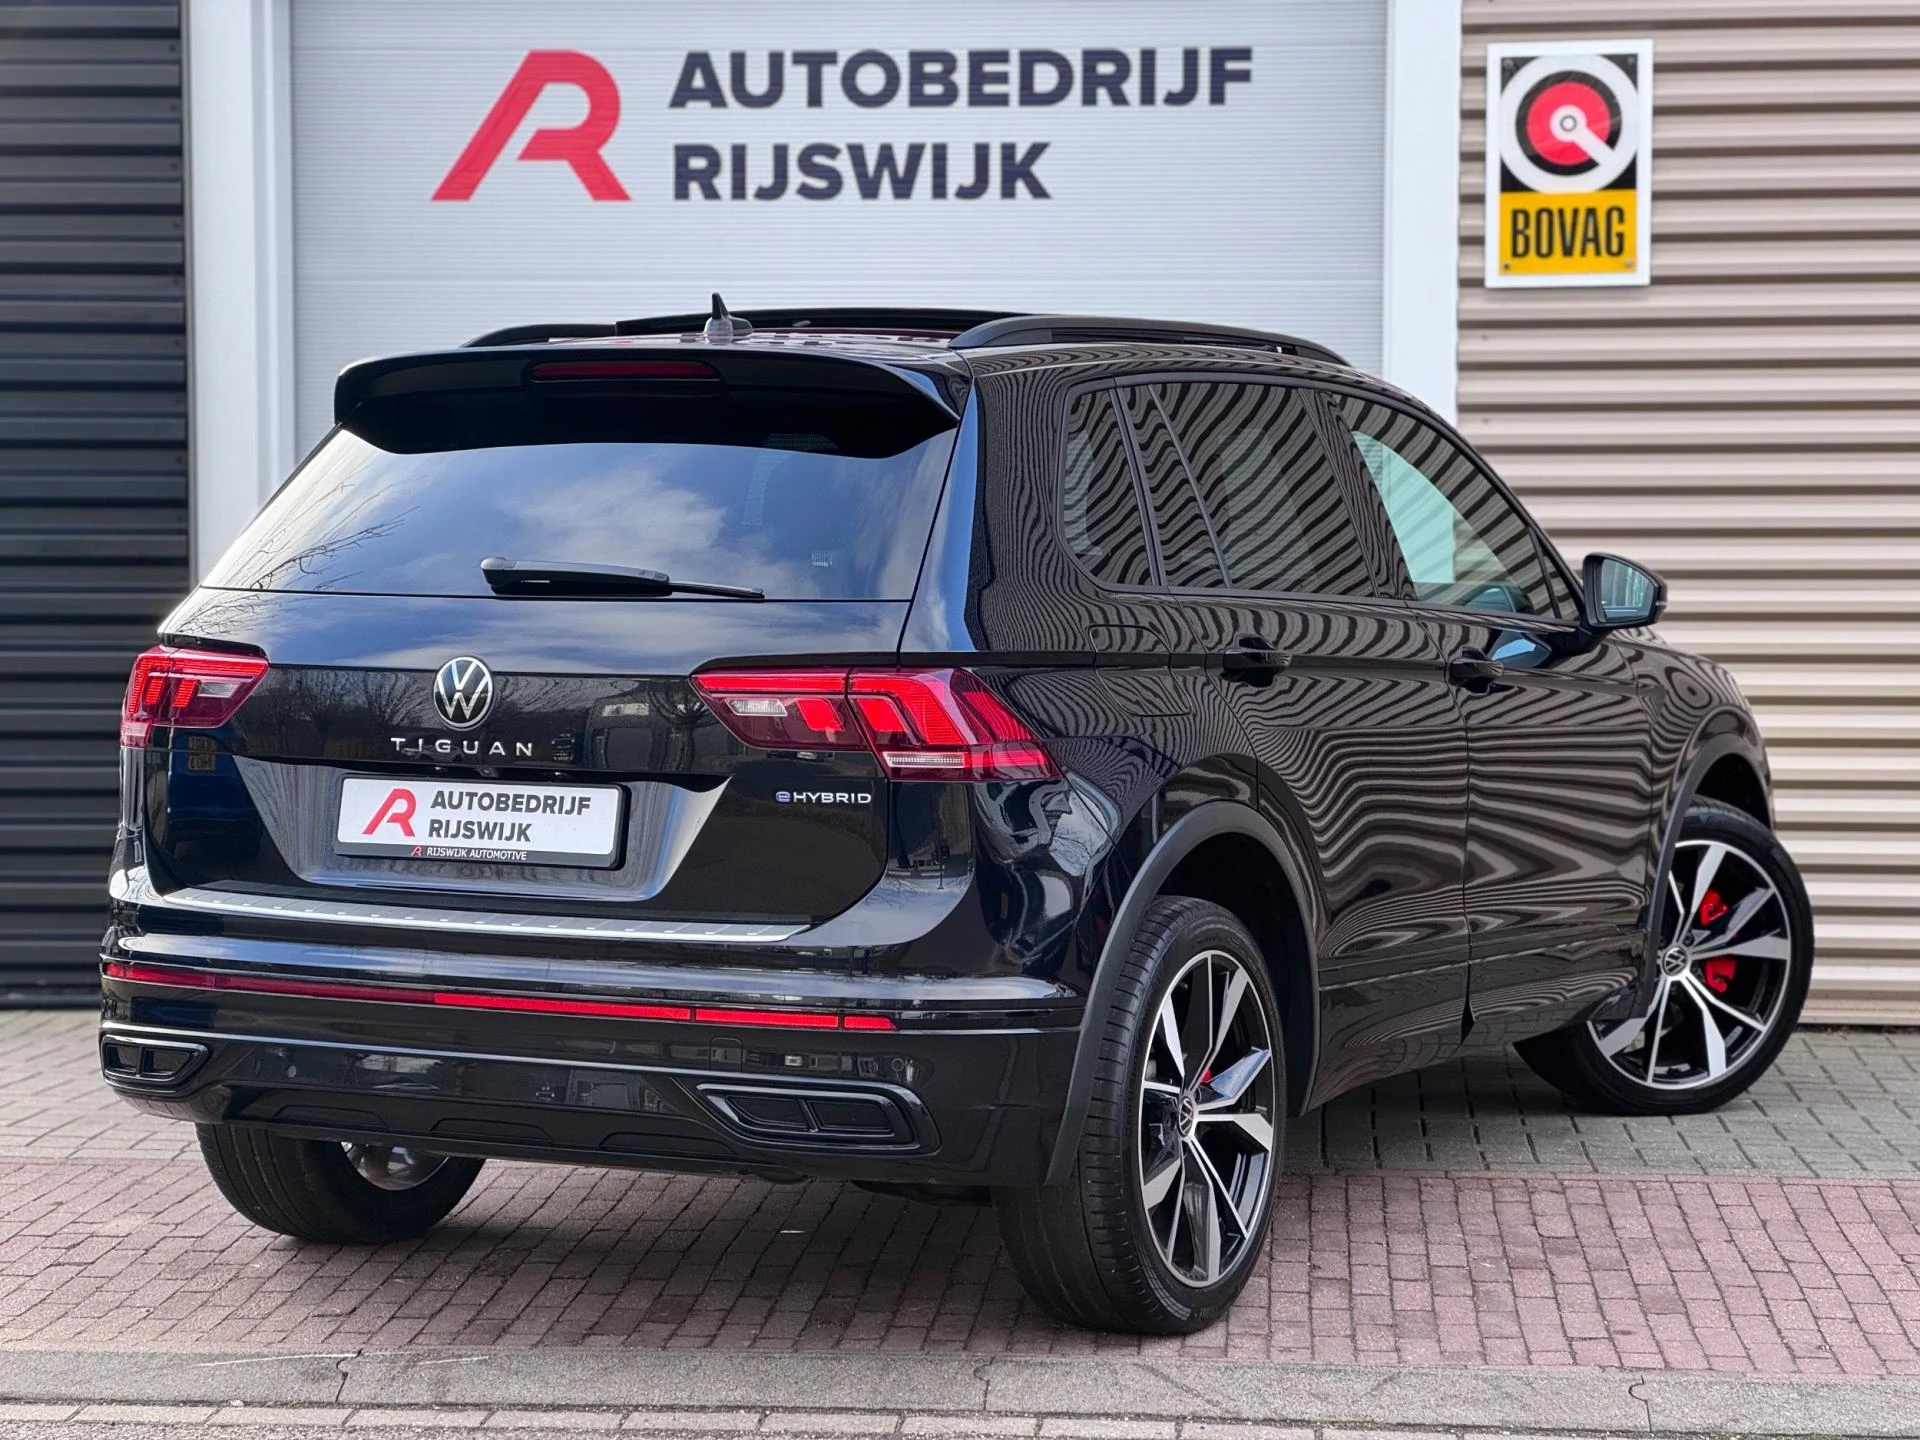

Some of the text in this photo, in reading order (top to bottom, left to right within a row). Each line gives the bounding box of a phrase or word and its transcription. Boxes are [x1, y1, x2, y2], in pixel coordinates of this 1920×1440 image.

[669, 47, 1253, 109] AUTOBEDRIJF
[673, 142, 1052, 201] RIJSWIJK
[1511, 206, 1626, 259] BOVAG
[390, 737, 533, 757] TIGUAN
[430, 790, 591, 815] AUTOBEDRIJF
[427, 819, 533, 842] RIJSWIJK
[427, 847, 527, 860] RIJSWIJK AUTOMOTIVE
